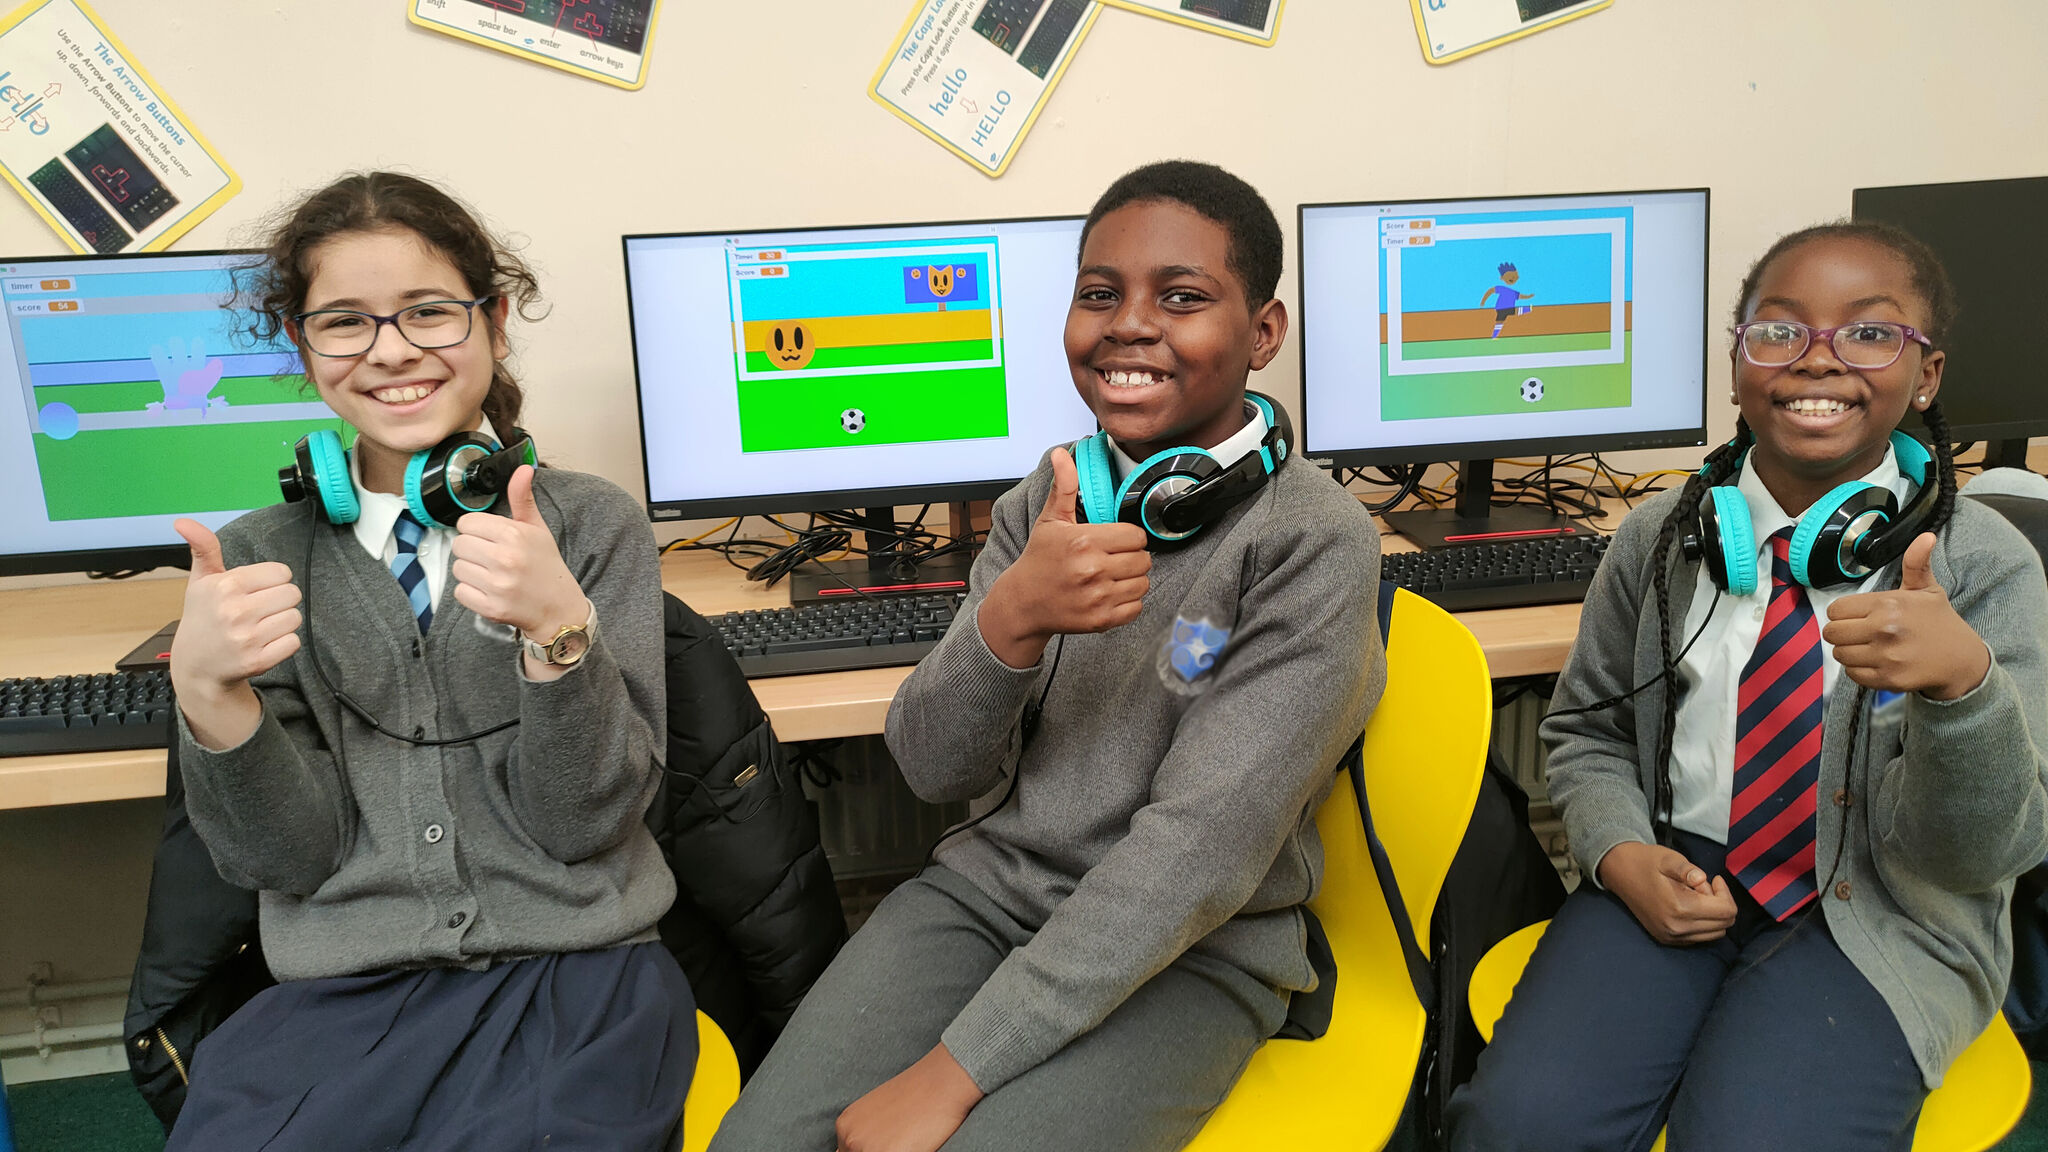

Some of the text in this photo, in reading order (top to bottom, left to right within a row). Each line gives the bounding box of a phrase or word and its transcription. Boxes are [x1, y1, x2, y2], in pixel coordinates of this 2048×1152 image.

[478, 19, 518, 36] space bar
[540, 38, 561, 49] enter
[901, 0, 947, 62] The Caps Lo
[901, 2, 960, 96] Press the Caps Lock Button
[923, 1, 975, 83] Press it again to type in
[580, 49, 624, 69] arrow keys
[57, 29, 192, 178] Use the Arrow Buttons to move the cursor
[57, 49, 170, 176] up, down, forwards and backwards.
[94, 42, 185, 146] The Arrow Buttons
[928, 68, 967, 117] hello
[971, 90, 1011, 147] HELLO
[11, 281, 33, 290] timer
